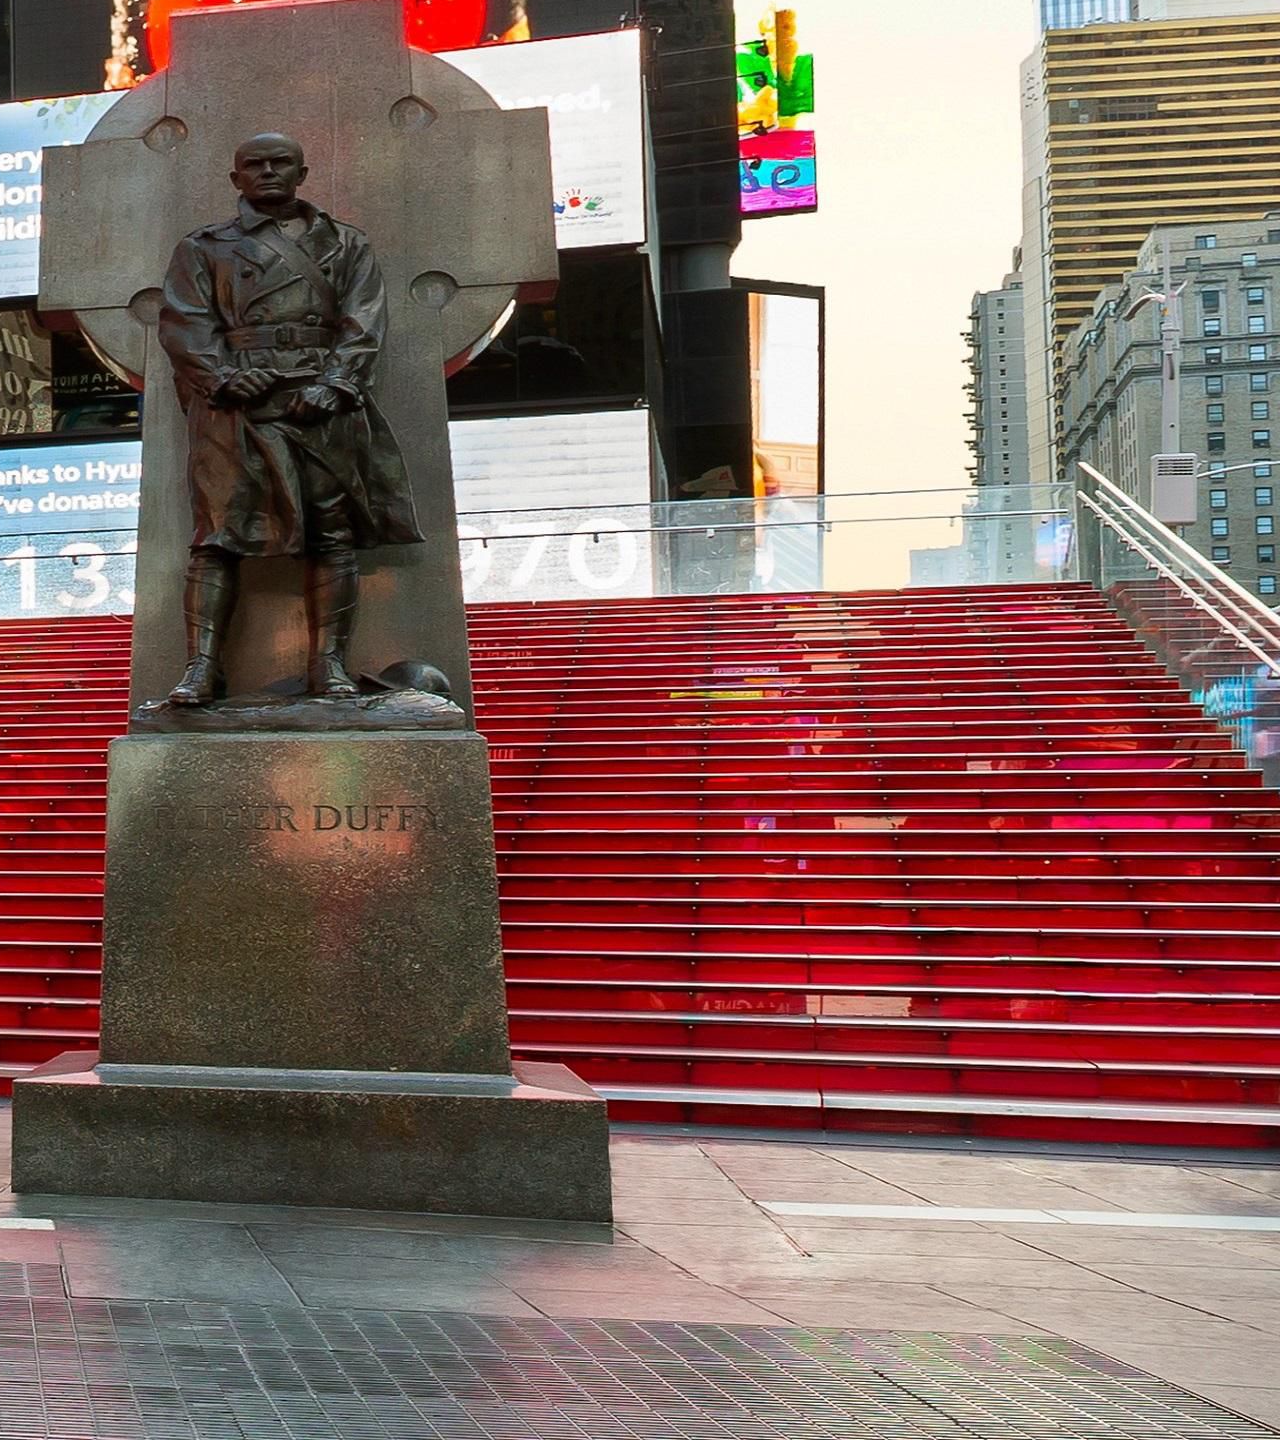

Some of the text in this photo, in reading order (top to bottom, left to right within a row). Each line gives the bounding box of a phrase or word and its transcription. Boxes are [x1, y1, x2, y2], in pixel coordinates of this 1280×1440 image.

[53, 464, 81, 483] to
[152, 804, 449, 832] FATHER DUFFY
